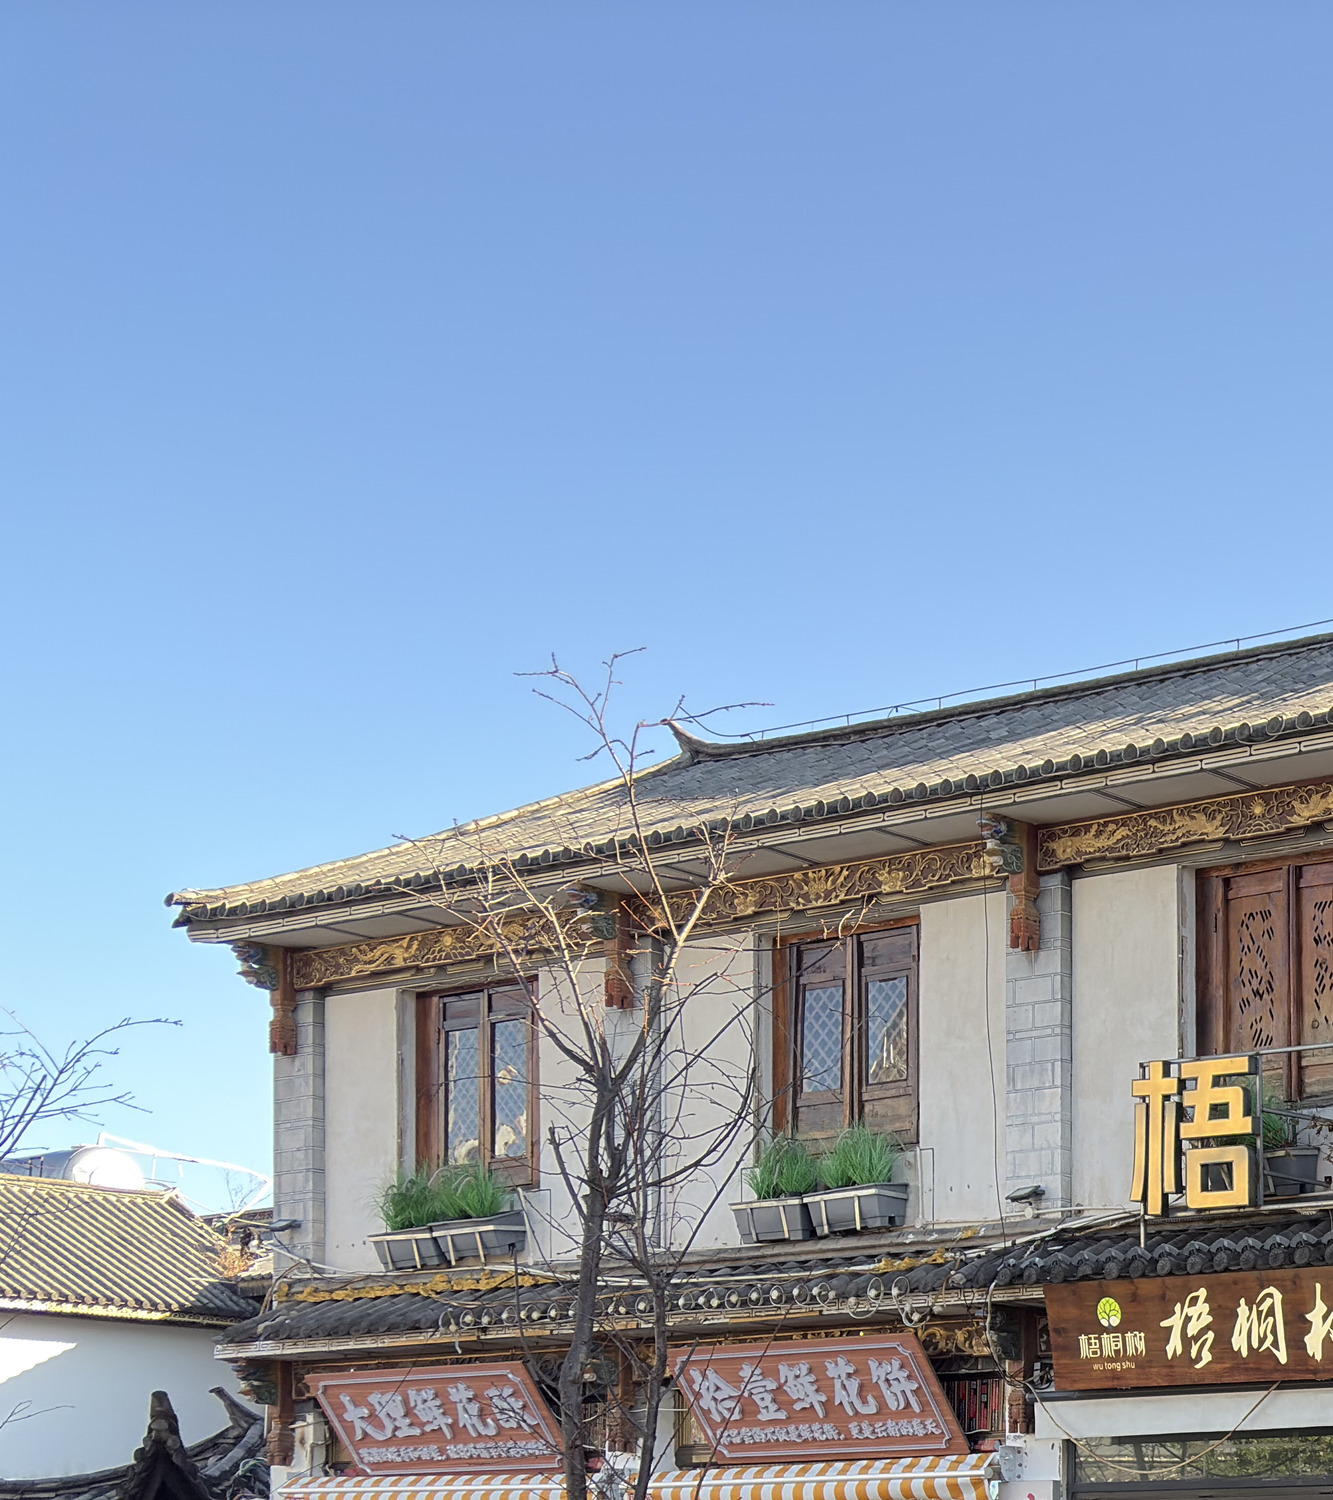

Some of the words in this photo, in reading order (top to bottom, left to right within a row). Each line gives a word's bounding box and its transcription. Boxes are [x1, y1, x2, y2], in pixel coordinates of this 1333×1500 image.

[1077, 1330, 1146, 1360] 梧桐树
[1092, 1362, 1104, 1370] wu
[1104, 1361, 1121, 1372] tong
[1122, 1360, 1136, 1369] shu
[689, 1354, 924, 1423] 拾壹鲜花饼
